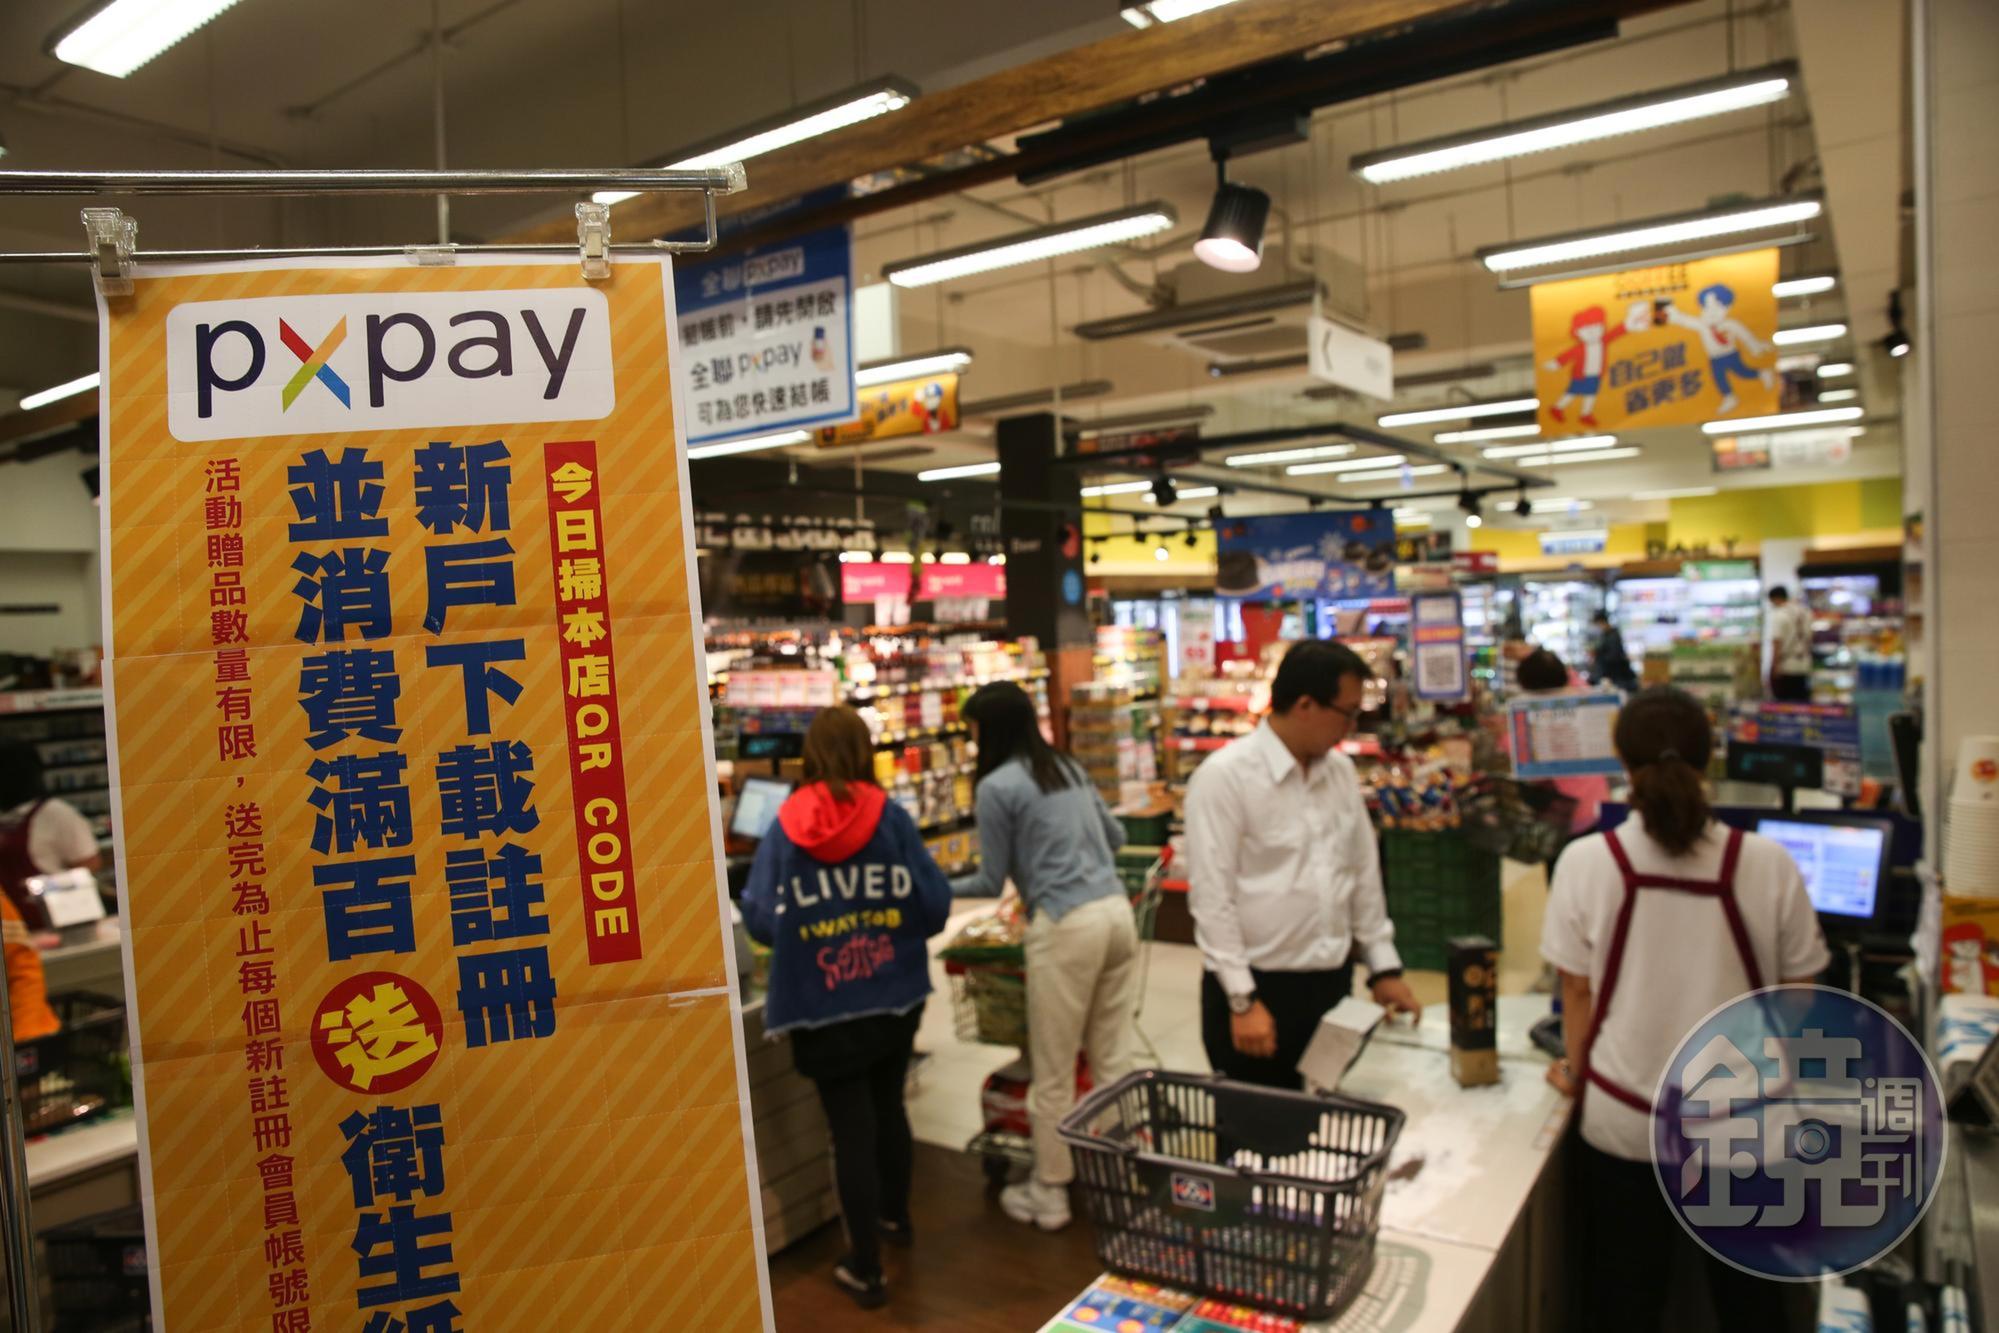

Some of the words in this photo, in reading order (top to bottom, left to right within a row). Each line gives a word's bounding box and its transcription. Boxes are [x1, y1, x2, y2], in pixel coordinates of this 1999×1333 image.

[195, 306, 587, 419] pxpay
[413, 439, 558, 1049] 新戶下載註冊
[583, 796, 630, 938] CODE
